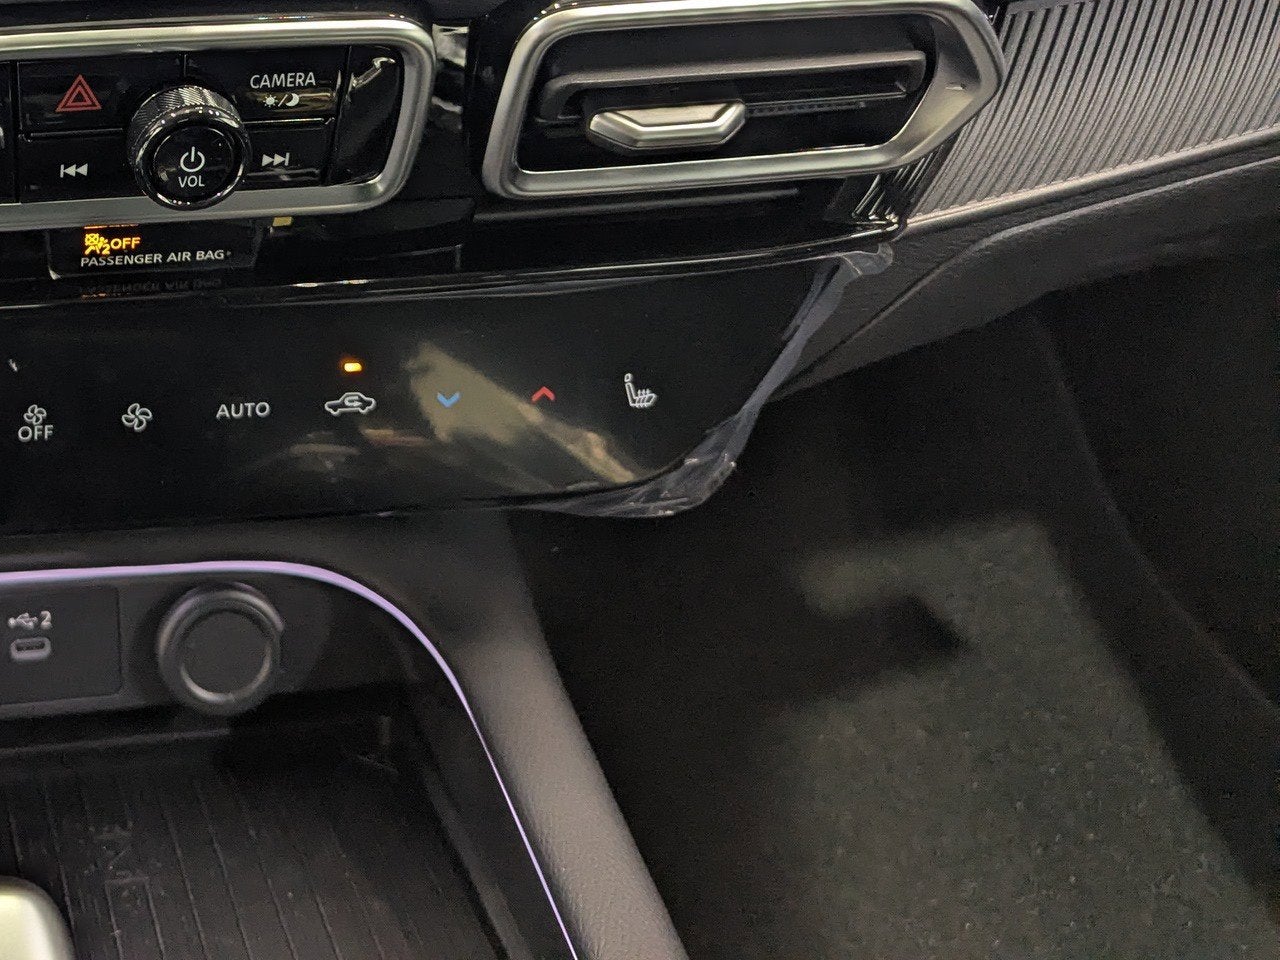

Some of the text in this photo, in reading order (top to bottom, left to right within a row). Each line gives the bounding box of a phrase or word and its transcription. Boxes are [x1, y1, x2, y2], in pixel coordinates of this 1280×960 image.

[250, 72, 315, 88] CAMERA
[178, 175, 204, 187] VOL
[81, 250, 224, 266] PASSENGER AIR BAG
[216, 402, 269, 418] AUTO
[18, 425, 53, 441] OFF
[39, 610, 52, 629] 2
